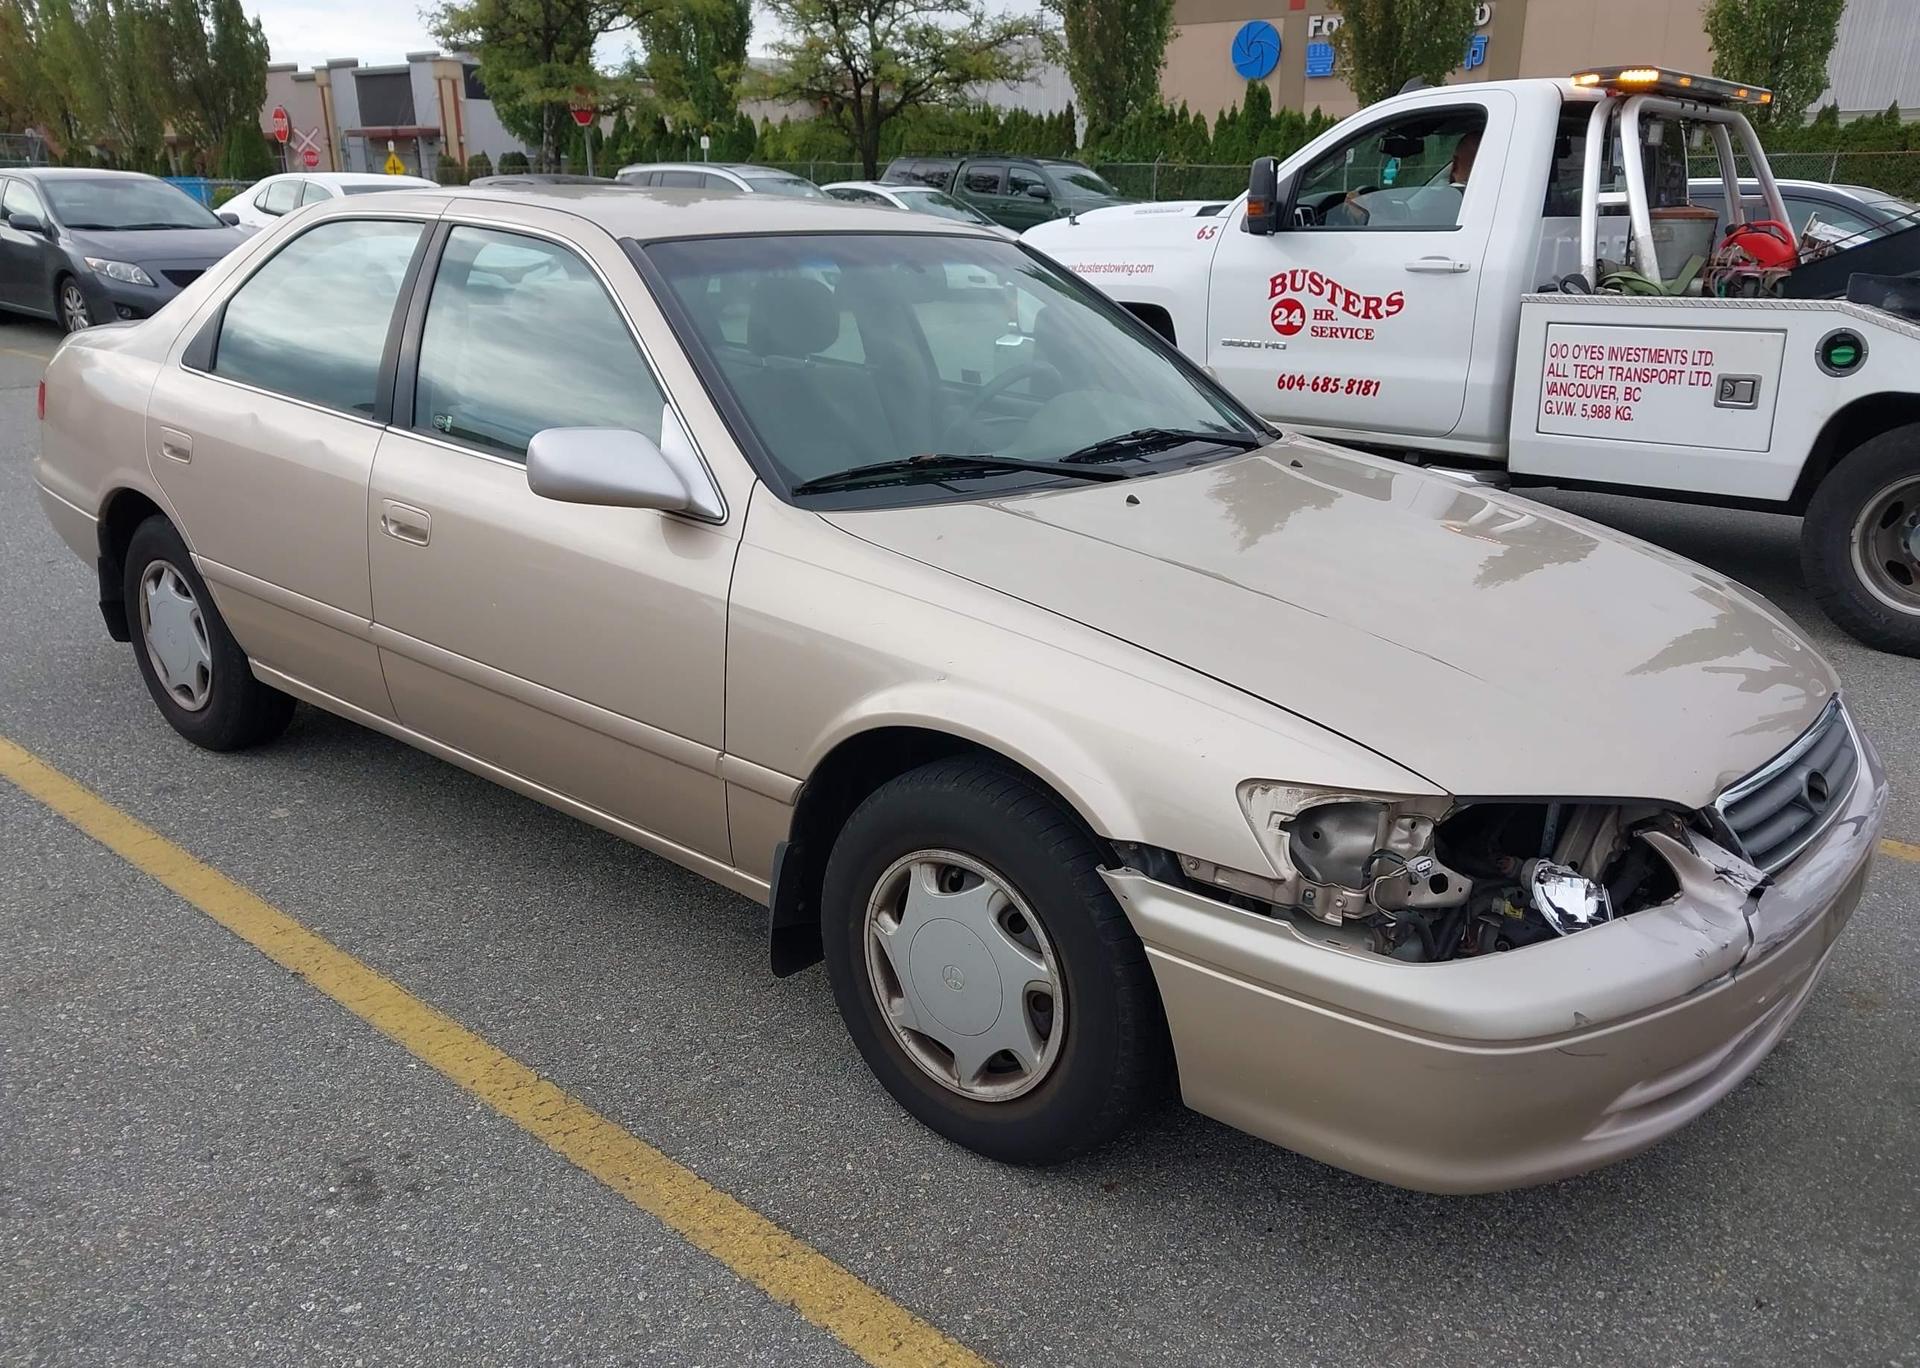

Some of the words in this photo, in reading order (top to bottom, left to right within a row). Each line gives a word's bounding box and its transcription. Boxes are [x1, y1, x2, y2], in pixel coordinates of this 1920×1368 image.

[1197, 225, 1218, 240] 65
[1268, 269, 1405, 320] BUSTERS
[1273, 307, 1303, 326] 24
[1313, 309, 1339, 321] HR.
[1310, 326, 1375, 340] SERVICE
[1572, 345, 1604, 361] O'YES
[1607, 347, 1688, 366] INVESTMENTS
[1691, 350, 1714, 367] LTD.
[1277, 374, 1380, 396] 604-685-8181
[1546, 363, 1569, 378] ALL
[1573, 364, 1604, 380] TECH
[1608, 366, 1685, 385] TRANSPORT
[1688, 371, 1713, 387] LTD.
[1546, 382, 1619, 403] VANCOUVER,
[1623, 387, 1642, 402] BC
[1544, 400, 1577, 416] G.V.W.
[1581, 403, 1611, 421] 5,988
[1615, 406, 1634, 421] KG.
